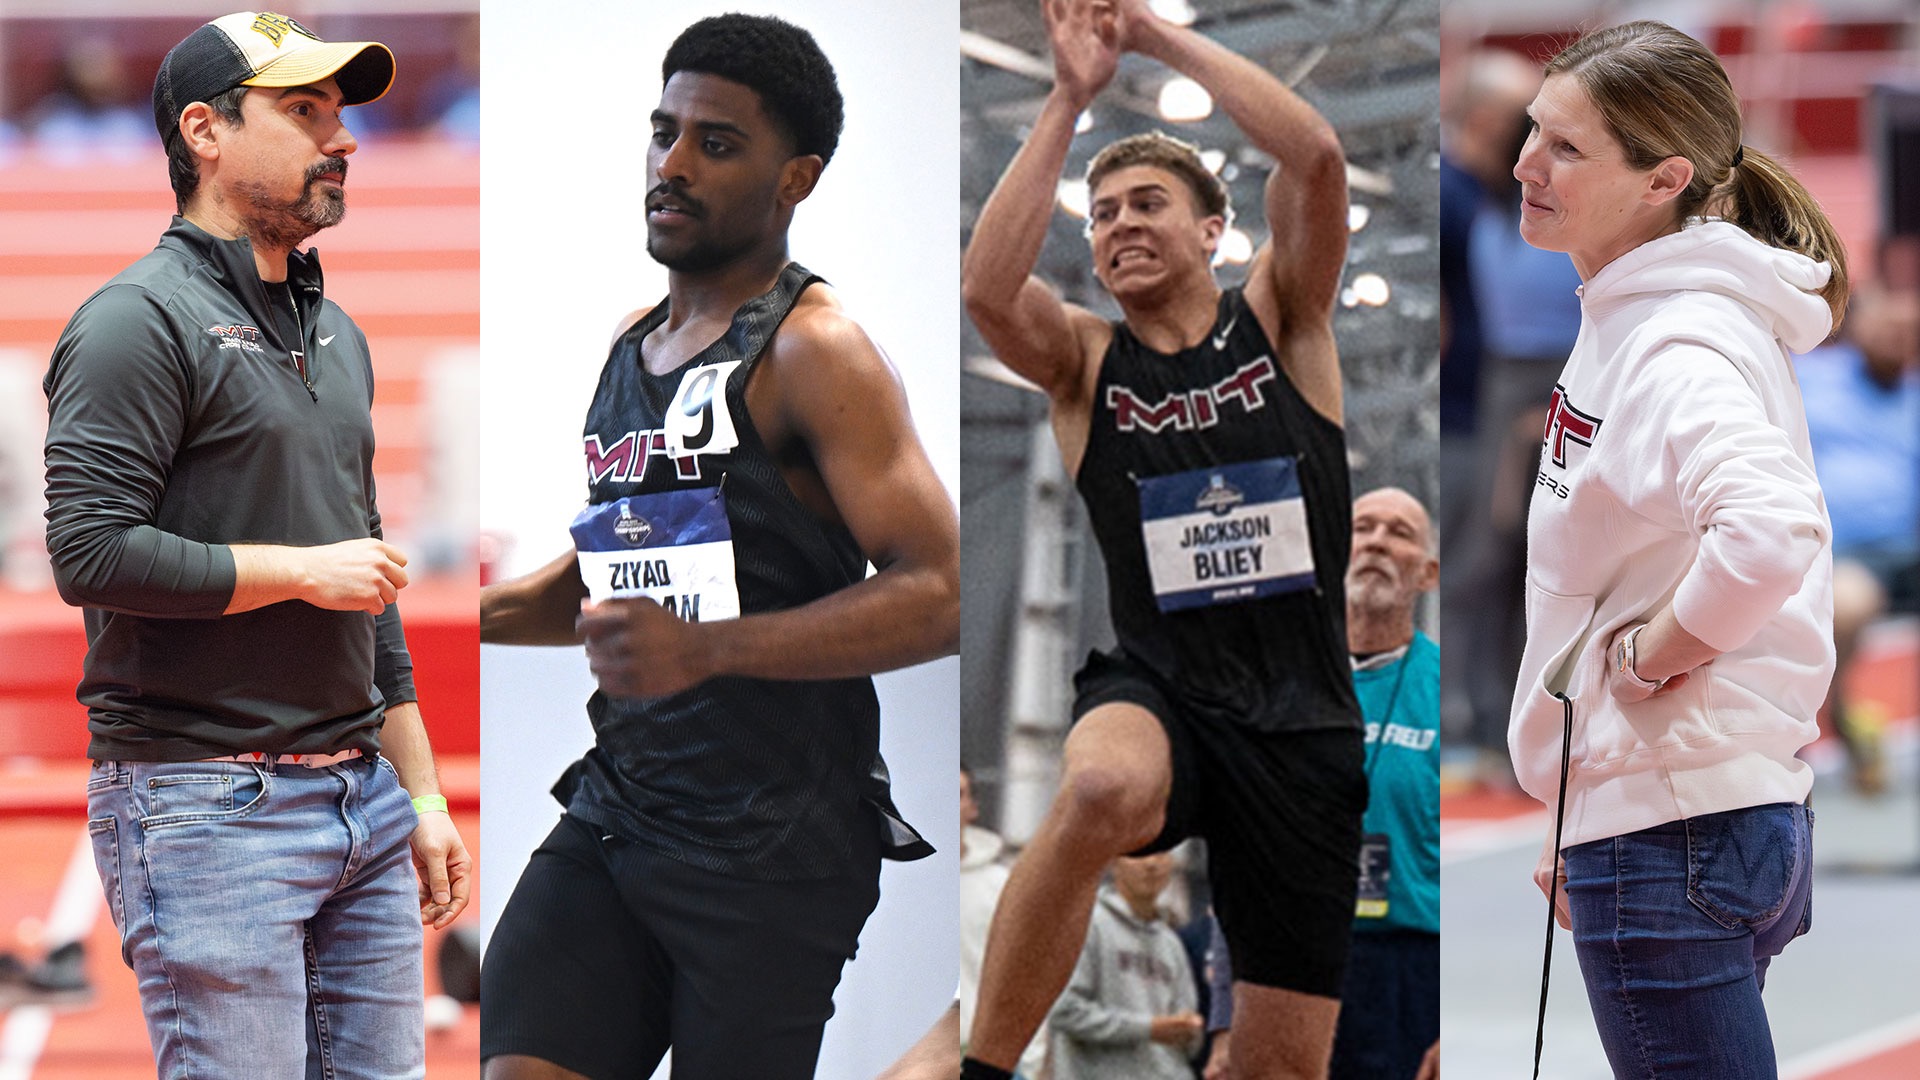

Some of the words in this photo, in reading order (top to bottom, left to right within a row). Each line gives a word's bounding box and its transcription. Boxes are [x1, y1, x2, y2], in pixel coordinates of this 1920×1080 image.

[208, 325, 259, 341] MIT
[681, 368, 719, 450] 9
[1106, 354, 1276, 434] MIT
[1180, 515, 1271, 548] JACKSON
[609, 559, 671, 590] ZIYAD
[1194, 545, 1263, 580] BLIEY
